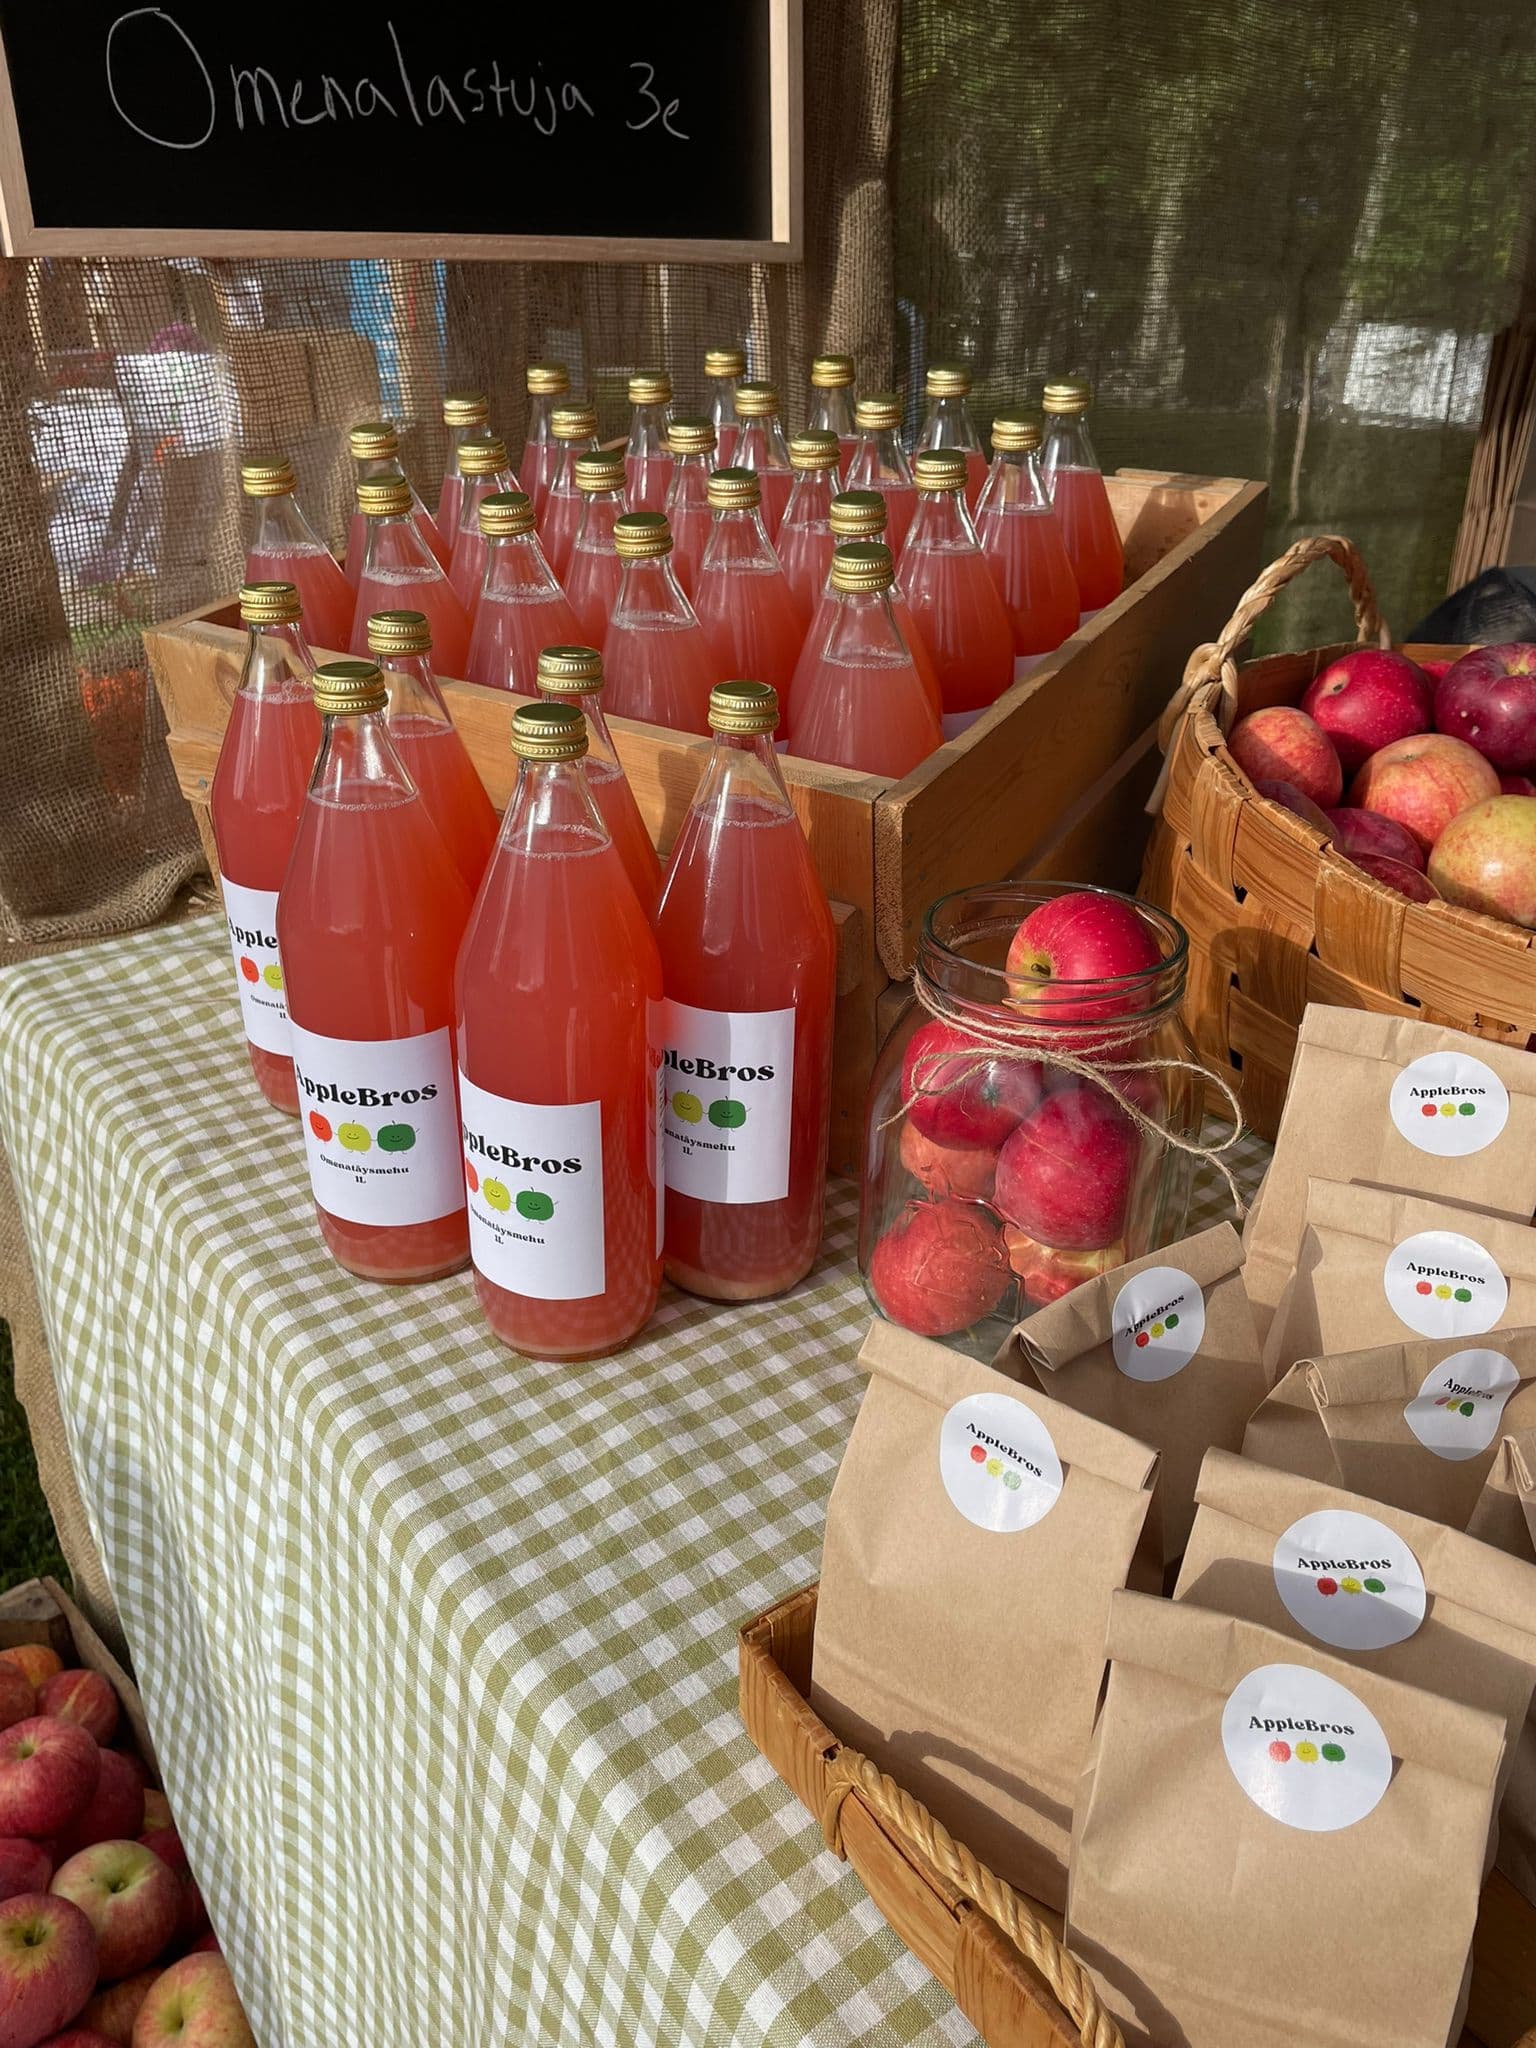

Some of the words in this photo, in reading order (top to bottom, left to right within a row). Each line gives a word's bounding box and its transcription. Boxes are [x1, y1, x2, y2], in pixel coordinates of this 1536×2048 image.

[106, 8, 594, 149] Omenalastuja
[1409, 1086, 1487, 1099] AppleBros
[319, 1153, 410, 1175] Omenatäysmehu
[1406, 1261, 1486, 1285] AppleBros
[1124, 1294, 1185, 1338] AppleBros
[966, 1422, 1043, 1478] AppleBros
[1297, 1557, 1392, 1571] AppleBros
[1249, 1715, 1355, 1736] AppleBros
